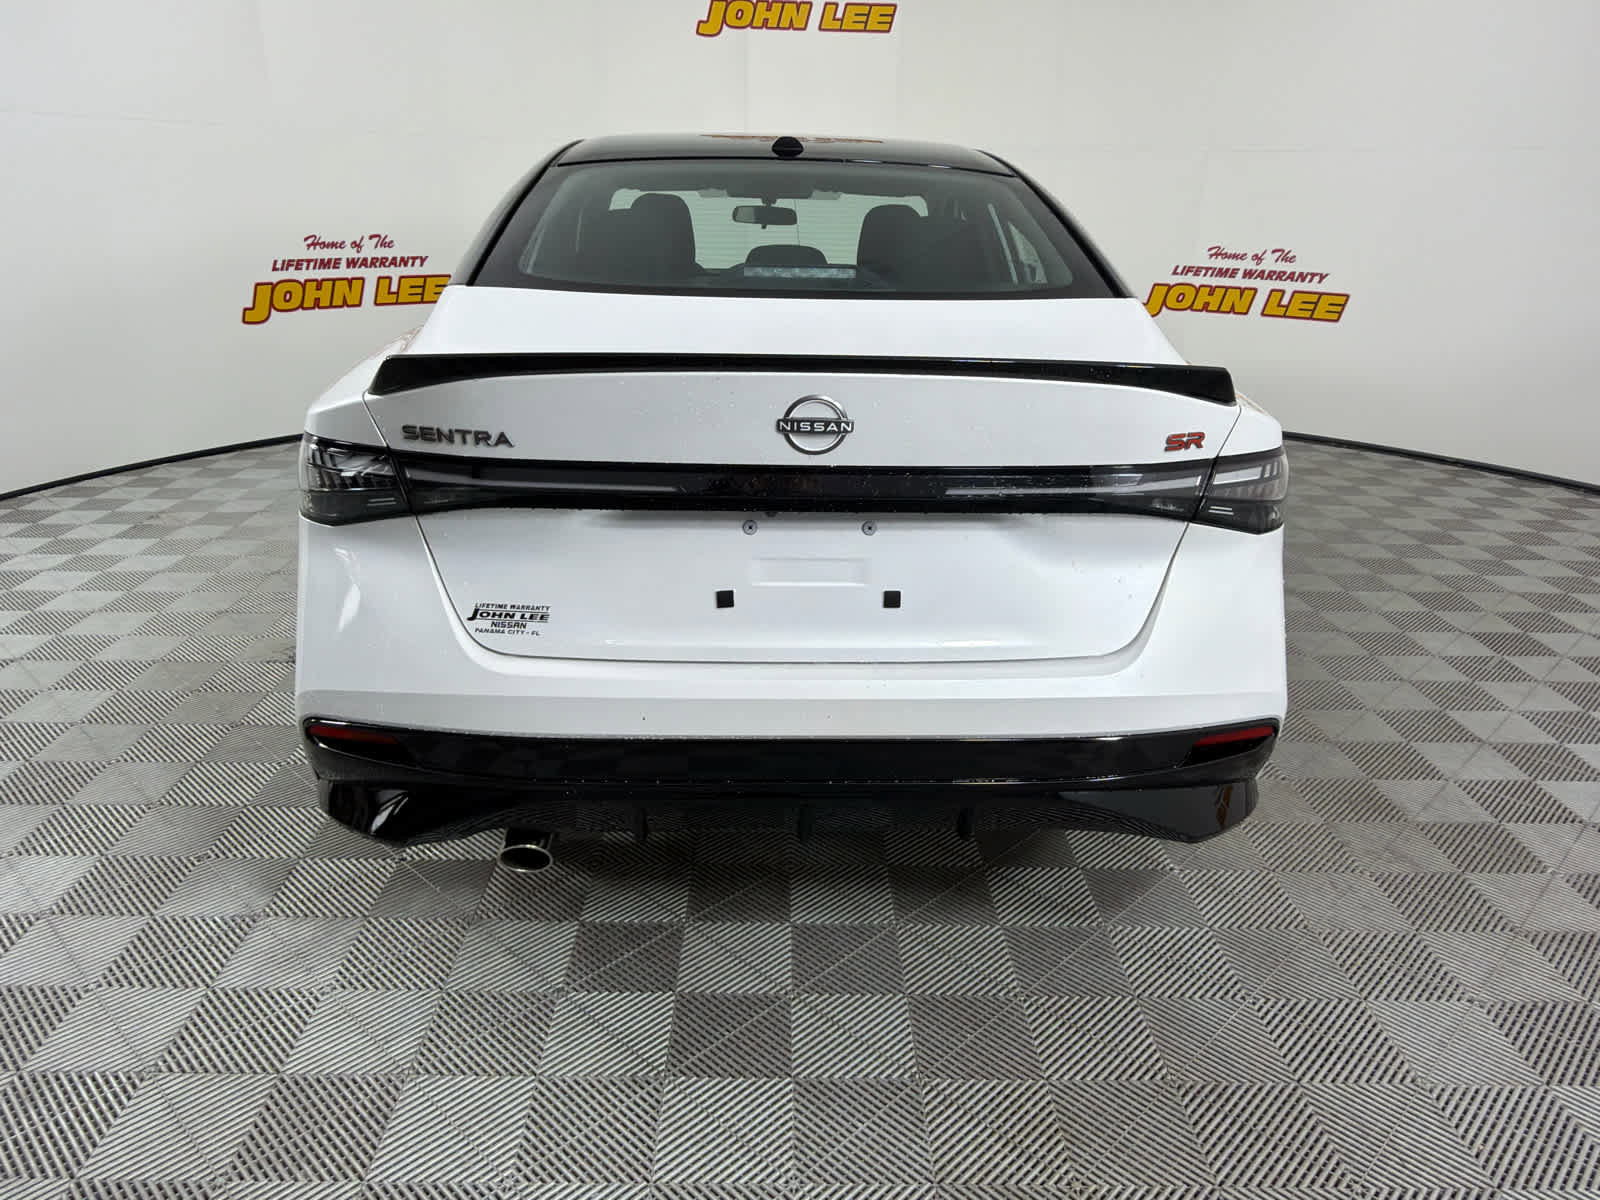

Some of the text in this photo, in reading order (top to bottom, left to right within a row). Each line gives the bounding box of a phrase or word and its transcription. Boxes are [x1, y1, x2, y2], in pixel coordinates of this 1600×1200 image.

[696, 0, 897, 36] JOHN LEE
[304, 234, 395, 253] Home of The
[271, 255, 429, 272] LIFETIME WARRANTY
[1208, 246, 1296, 265] Home of The
[1171, 265, 1329, 284] LIFETIME WARRANTY
[242, 274, 451, 325] JOHN LEE
[1143, 283, 1351, 323] JOHN LEE
[779, 420, 852, 432] NISSAN
[402, 424, 515, 448] SENTRA
[1164, 431, 1206, 452] SR
[467, 608, 550, 621] JOHN LEE
[491, 621, 527, 629] NISSAN
